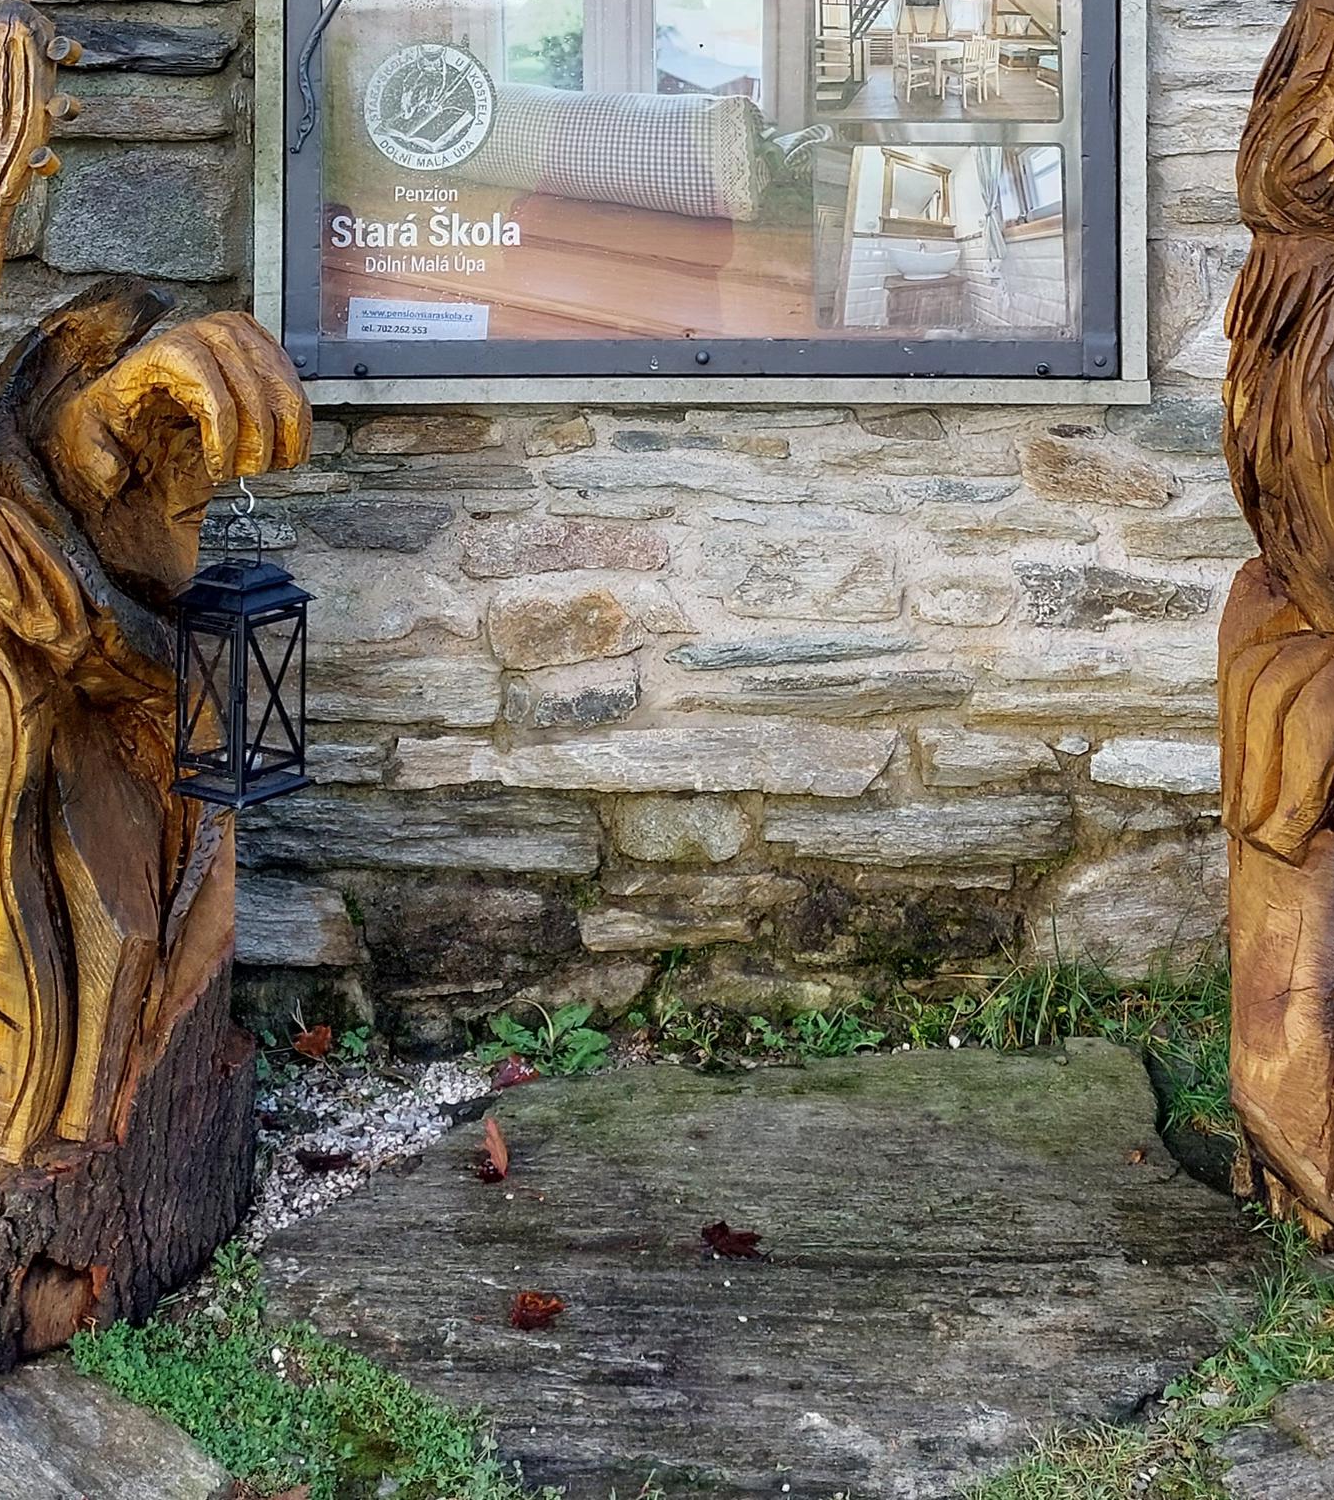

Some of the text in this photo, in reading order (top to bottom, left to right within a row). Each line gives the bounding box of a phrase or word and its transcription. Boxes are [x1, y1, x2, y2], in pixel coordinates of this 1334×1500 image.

[455, 57, 487, 127] U KOSTELA
[395, 186, 458, 202] Penzion
[331, 206, 521, 248] Stará Škola
[366, 252, 485, 276] Dolní Malá Úpa
